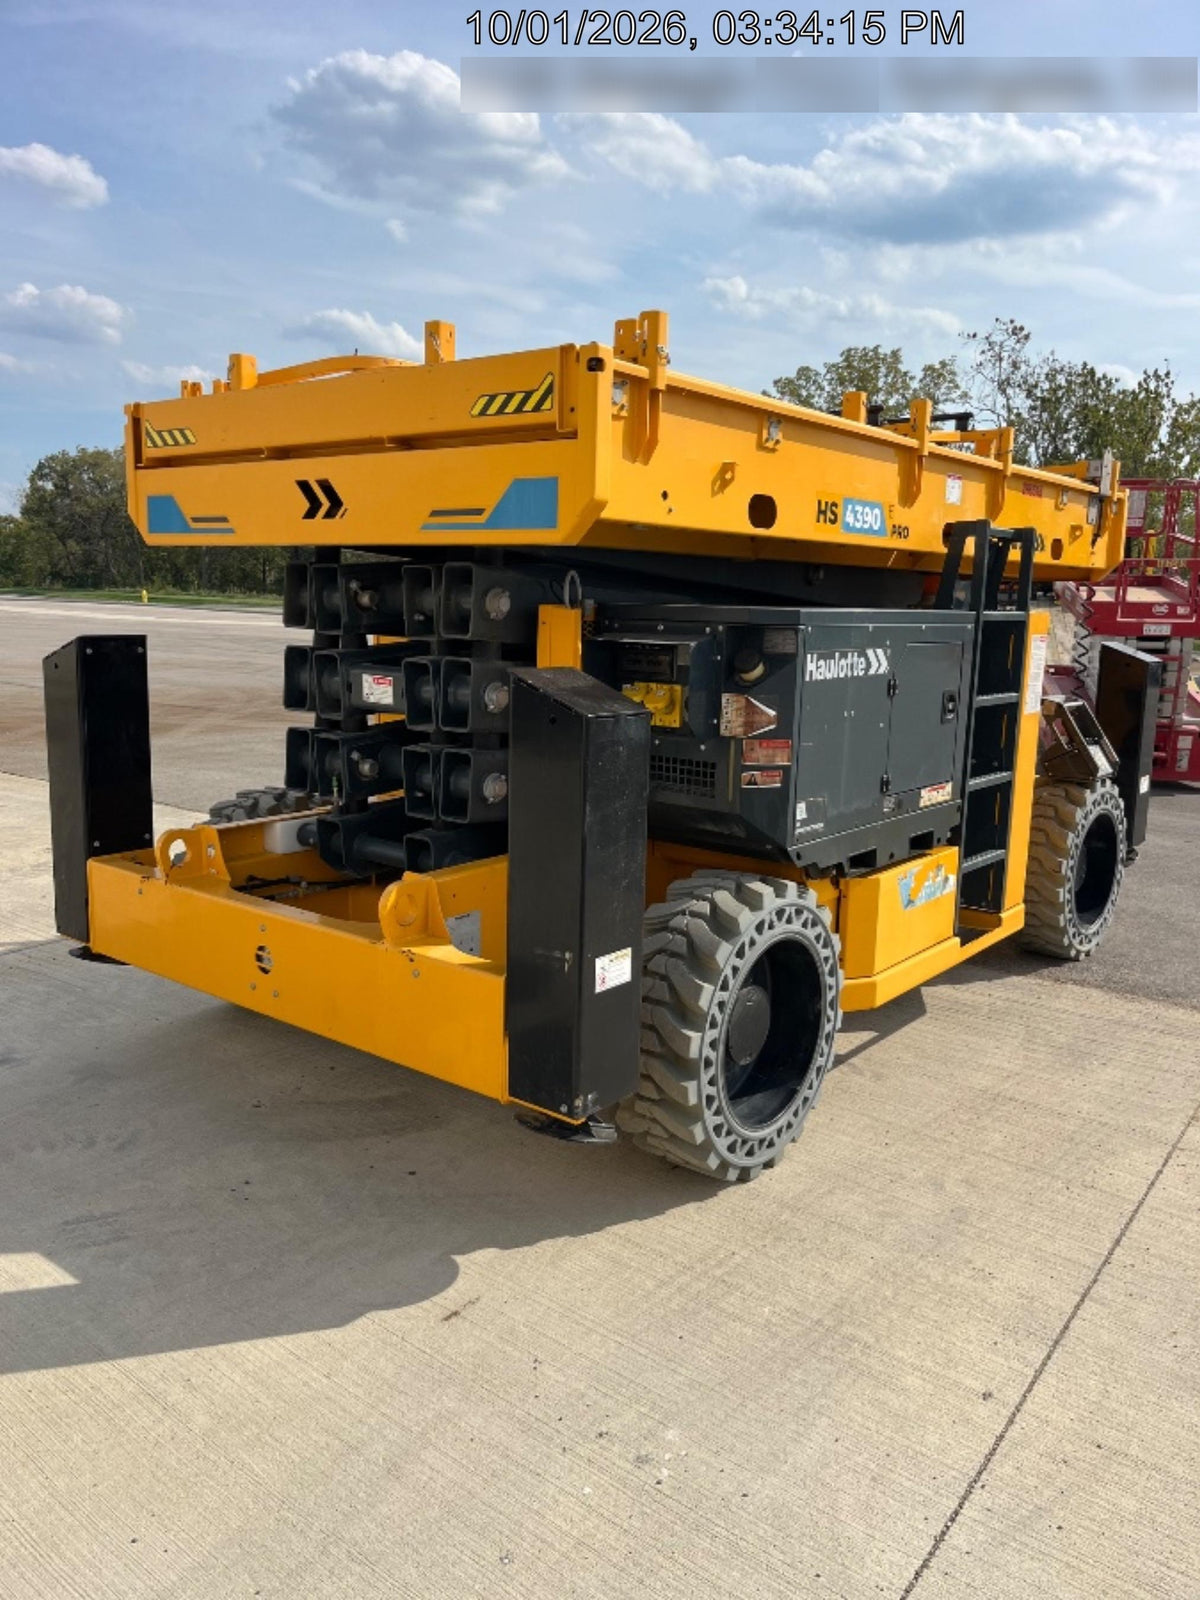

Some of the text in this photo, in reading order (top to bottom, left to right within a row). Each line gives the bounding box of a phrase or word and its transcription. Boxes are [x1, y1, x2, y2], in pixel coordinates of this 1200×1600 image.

[816, 499, 881, 531] HS 4390
[891, 524, 909, 539] PRO
[805, 651, 866, 681] Haulotte
